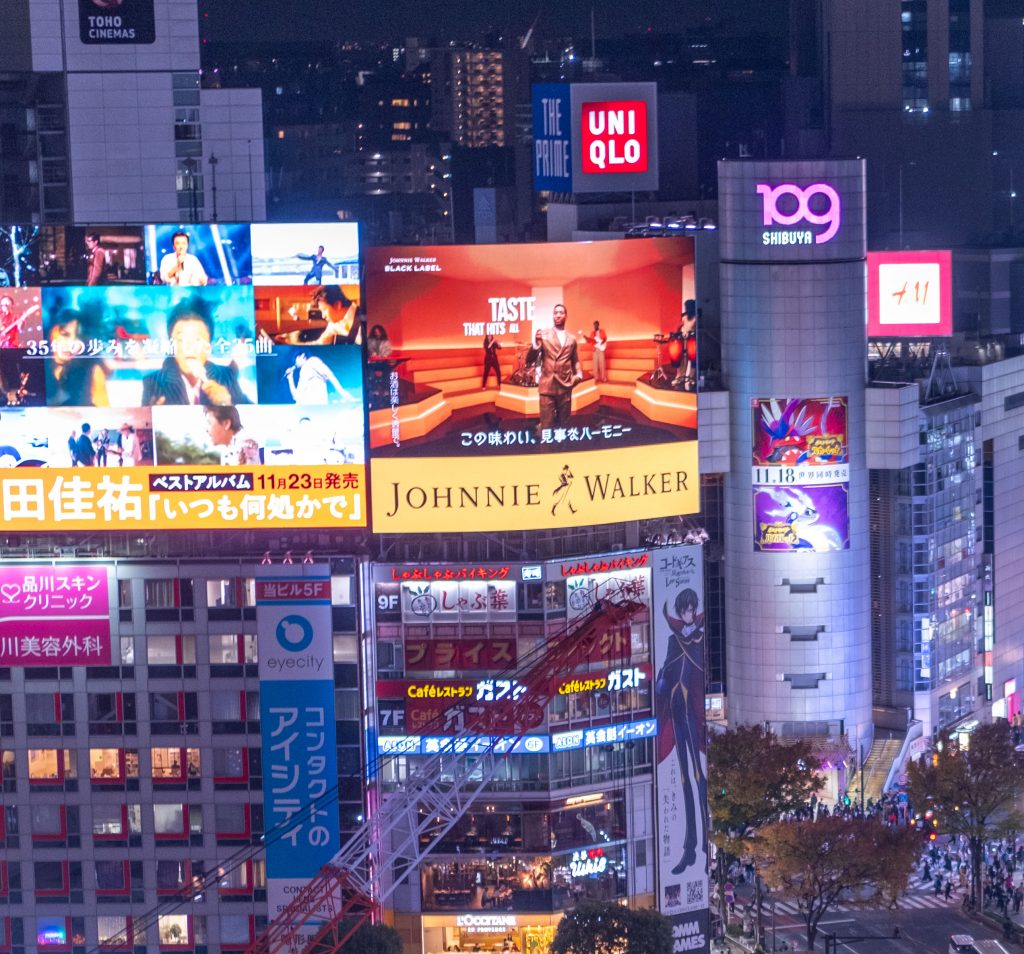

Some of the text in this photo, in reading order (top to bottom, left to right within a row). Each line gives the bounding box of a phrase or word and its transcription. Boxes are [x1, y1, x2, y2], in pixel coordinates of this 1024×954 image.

[88, 16, 122, 27] TOHO
[89, 29, 136, 39] CINEMAS
[541, 98, 562, 136] THE
[589, 110, 635, 135] UNI
[536, 139, 569, 177] PRIME
[589, 139, 641, 169] QLO
[756, 183, 841, 244] 109
[762, 230, 813, 245] SHIBUYA
[413, 264, 442, 272] LABEL
[488, 296, 536, 322] TASTE
[463, 322, 519, 336] THAT HITS ALL
[461, 425, 632, 447] この味わい、見事なハーモニー
[152, 474, 251, 490] ベストアルバム
[257, 472, 360, 490] 11月23日発売
[755, 468, 795, 484] 11.18
[2, 475, 144, 521] 田佳祐
[386, 470, 689, 517] JOHNNIE WALKER
[149, 493, 361, 521] 「いつも何処かで」
[392, 566, 510, 580] しゃぶしゃぶバイキング
[561, 554, 649, 577] しゃぶしゃぶバイキング
[22, 575, 101, 592] 品川スキン
[263, 583, 323, 598] 当ビル5F
[22, 594, 93, 610] クリニック
[378, 595, 399, 610] 9F
[442, 590, 509, 610] しゃぶ葉
[0, 635, 103, 657] 川美容外科
[406, 642, 513, 665] プライス
[267, 655, 324, 671] eyecity
[607, 667, 646, 691] ガスト
[380, 709, 405, 726] 7F
[585, 722, 655, 745] 英会話イーオン
[268, 706, 302, 847] アイシティ
[305, 706, 330, 847] コンタクトの
[673, 934, 706, 954] AMES
